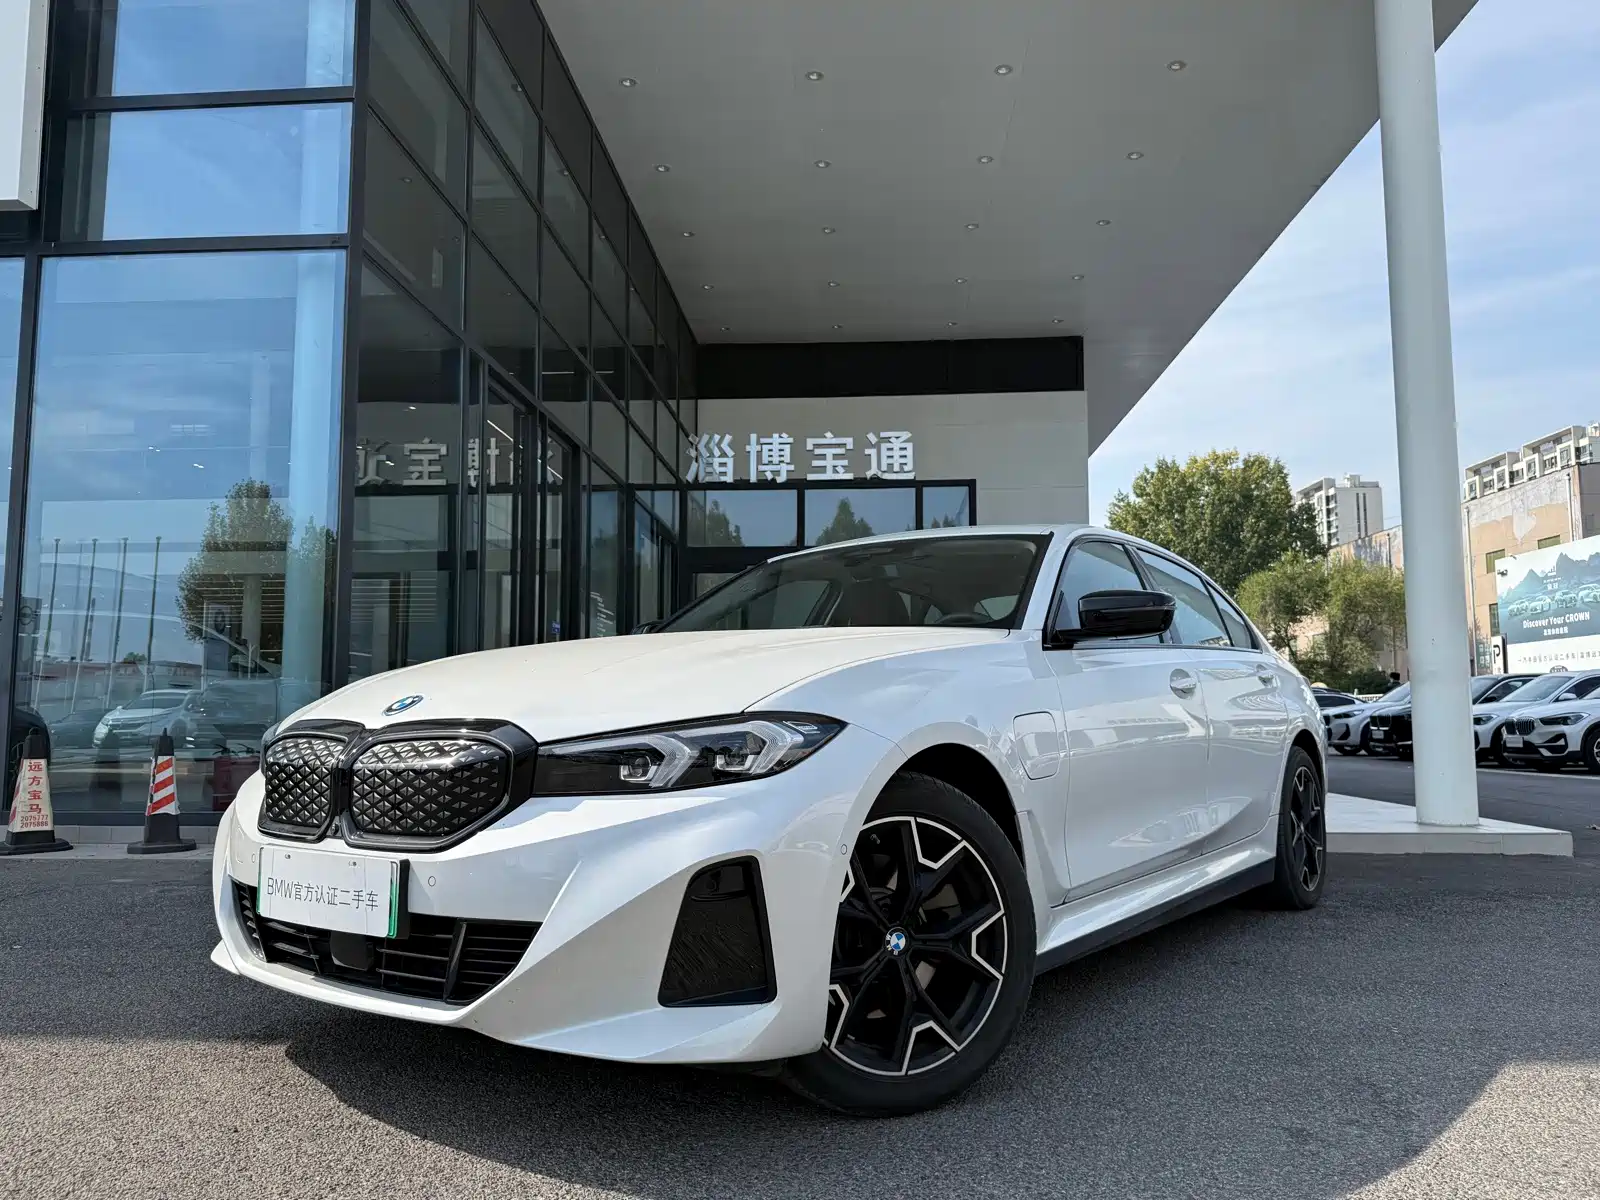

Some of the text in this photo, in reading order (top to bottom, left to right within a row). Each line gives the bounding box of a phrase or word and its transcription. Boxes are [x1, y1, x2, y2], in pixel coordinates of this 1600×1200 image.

[685, 431, 916, 483] 淄博宝通
[1523, 611, 1590, 629] Discover Your CROWN
[28, 761, 43, 813] 远方宝马
[267, 877, 379, 911] BMW官方认证二手车
